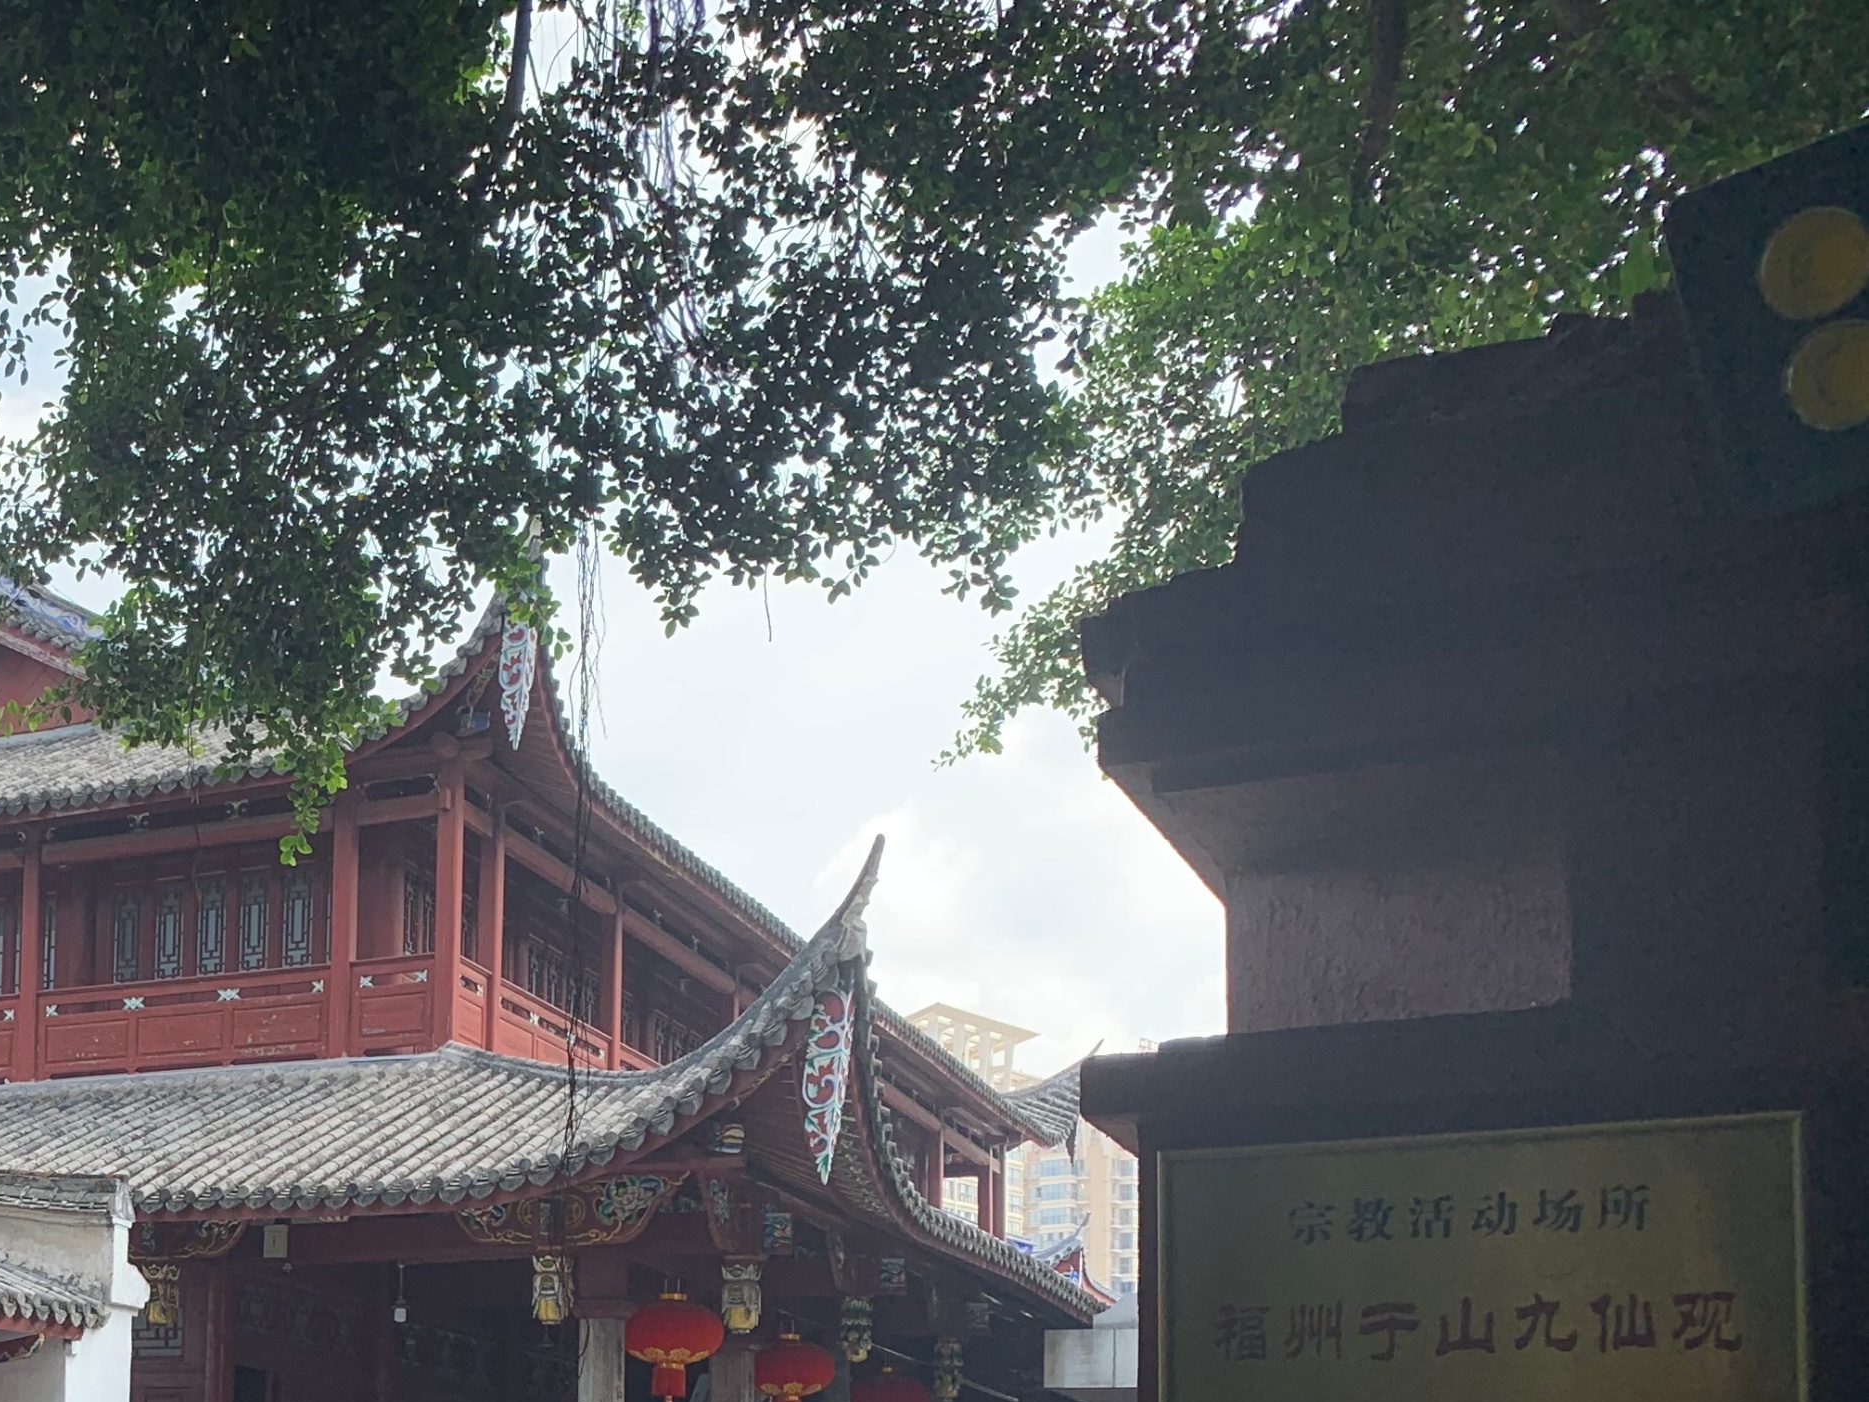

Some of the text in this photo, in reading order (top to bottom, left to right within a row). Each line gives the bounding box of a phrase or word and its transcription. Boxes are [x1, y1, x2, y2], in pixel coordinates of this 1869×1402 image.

[1288, 1184, 1650, 1246] 宗教活动场所
[1214, 1289, 1744, 1364] 福州于山九仙观
